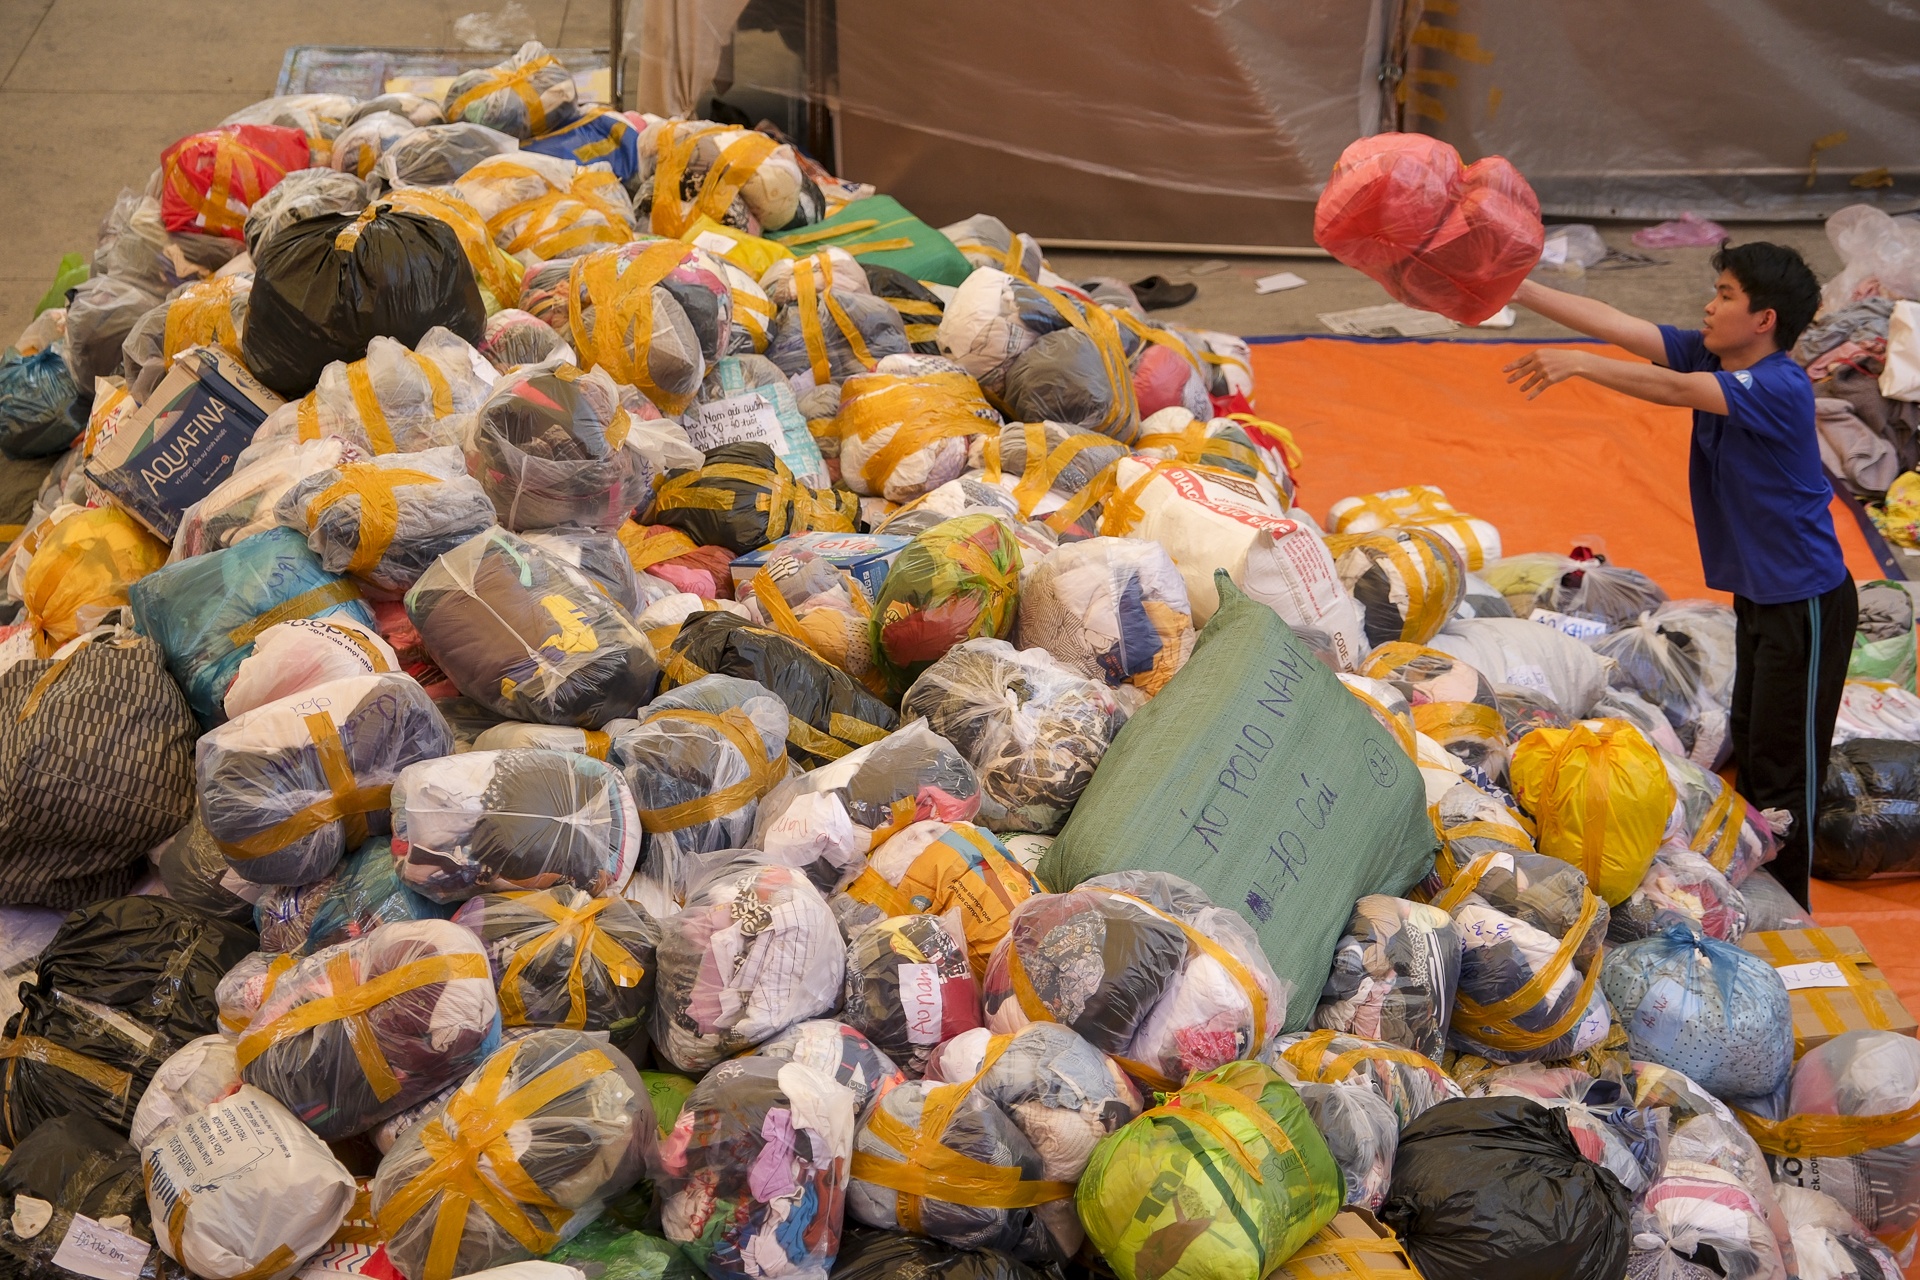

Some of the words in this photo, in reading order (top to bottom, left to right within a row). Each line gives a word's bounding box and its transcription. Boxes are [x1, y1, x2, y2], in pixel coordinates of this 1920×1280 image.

[228, 361, 280, 401] AQUAFINA
[141, 396, 226, 497] AQUAFINA
[1333, 631, 1350, 664] CODE:
[1179, 803, 1229, 853] ÁO
[1218, 724, 1274, 799] POLO
[1257, 641, 1316, 718] NAM
